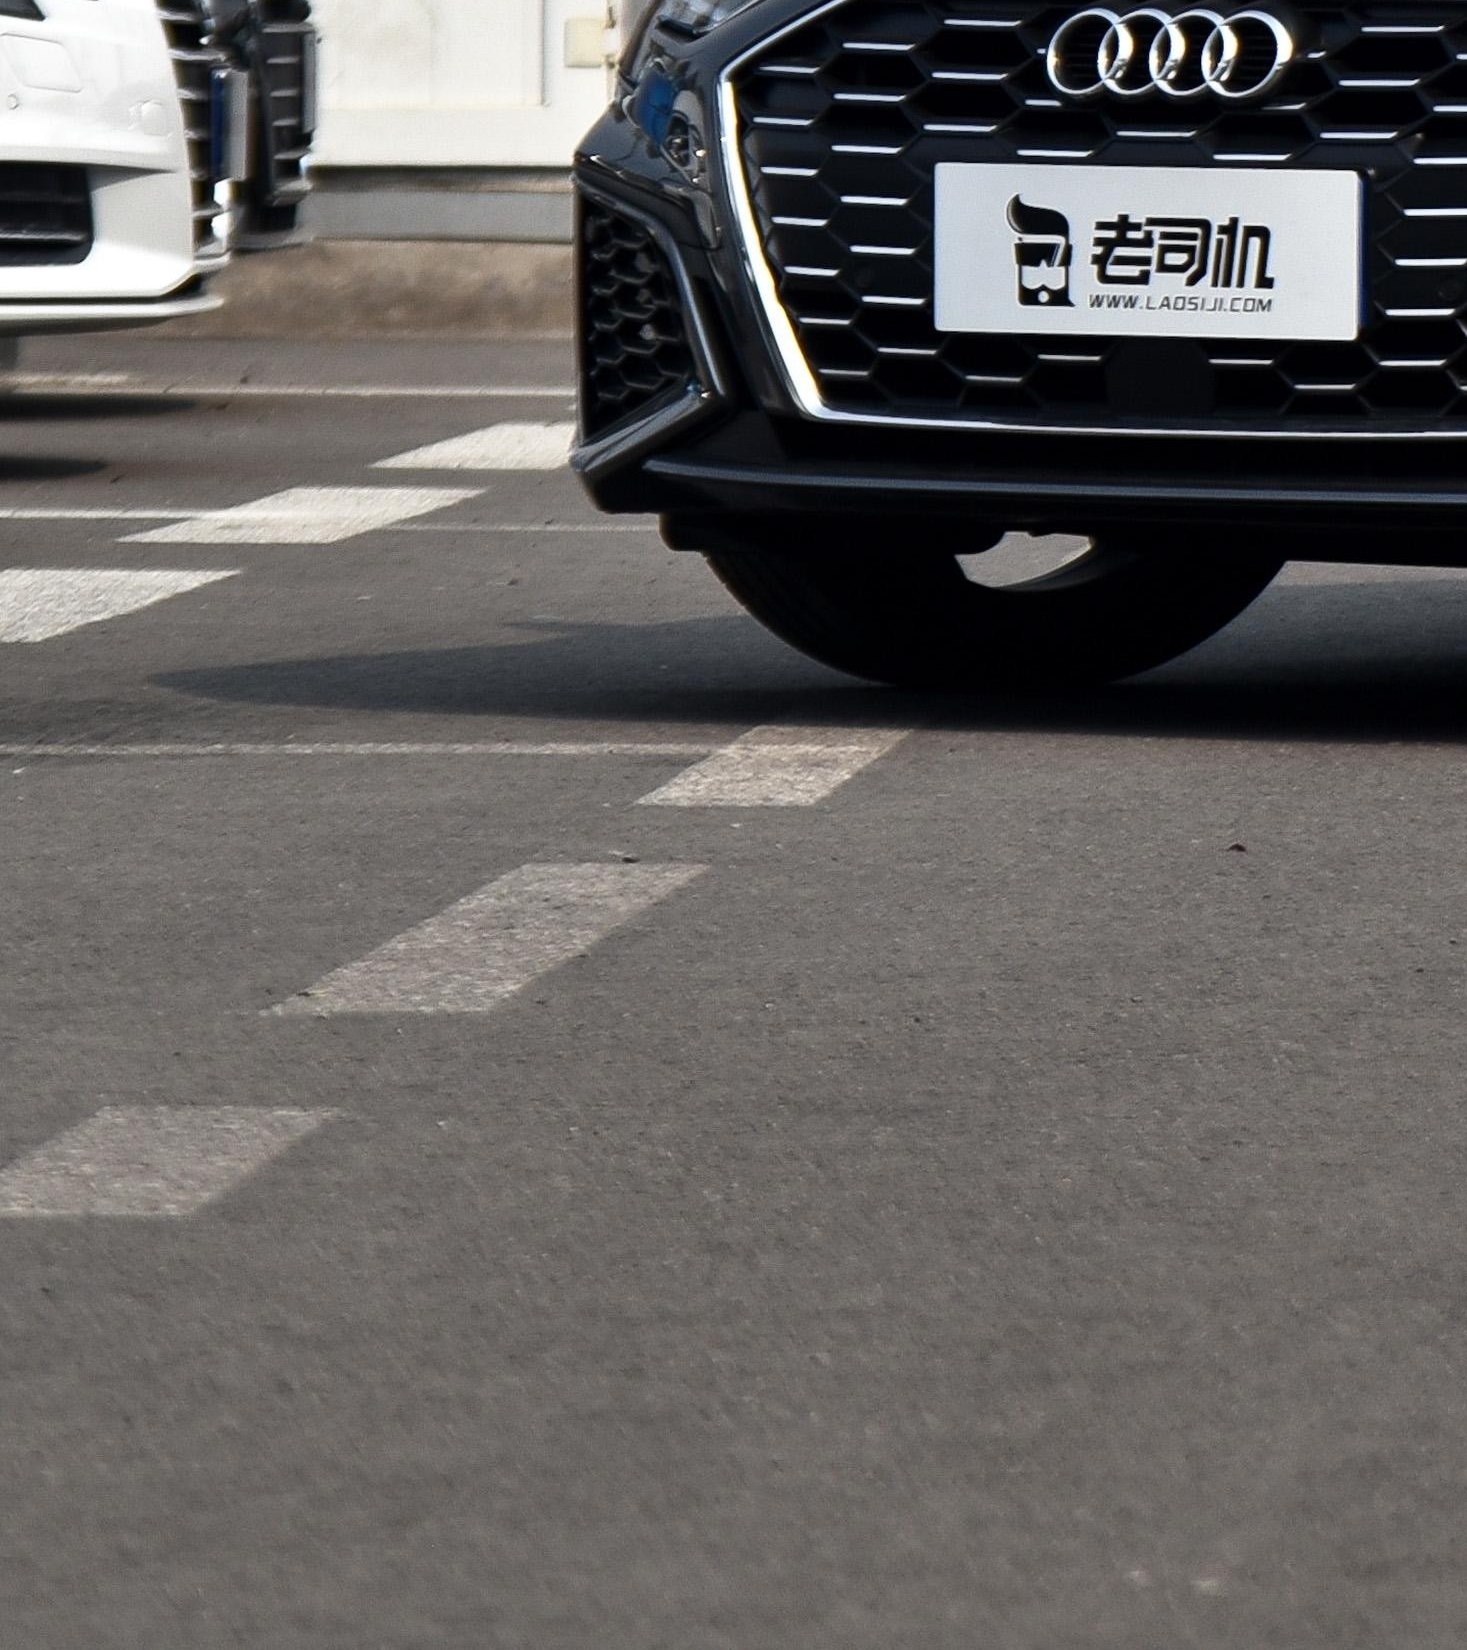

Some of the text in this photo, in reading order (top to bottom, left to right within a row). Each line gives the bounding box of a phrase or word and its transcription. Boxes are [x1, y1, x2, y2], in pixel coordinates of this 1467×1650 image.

[1090, 213, 1276, 289] 老司机
[1088, 293, 1274, 314] WWW.LAOSIJI.COM
